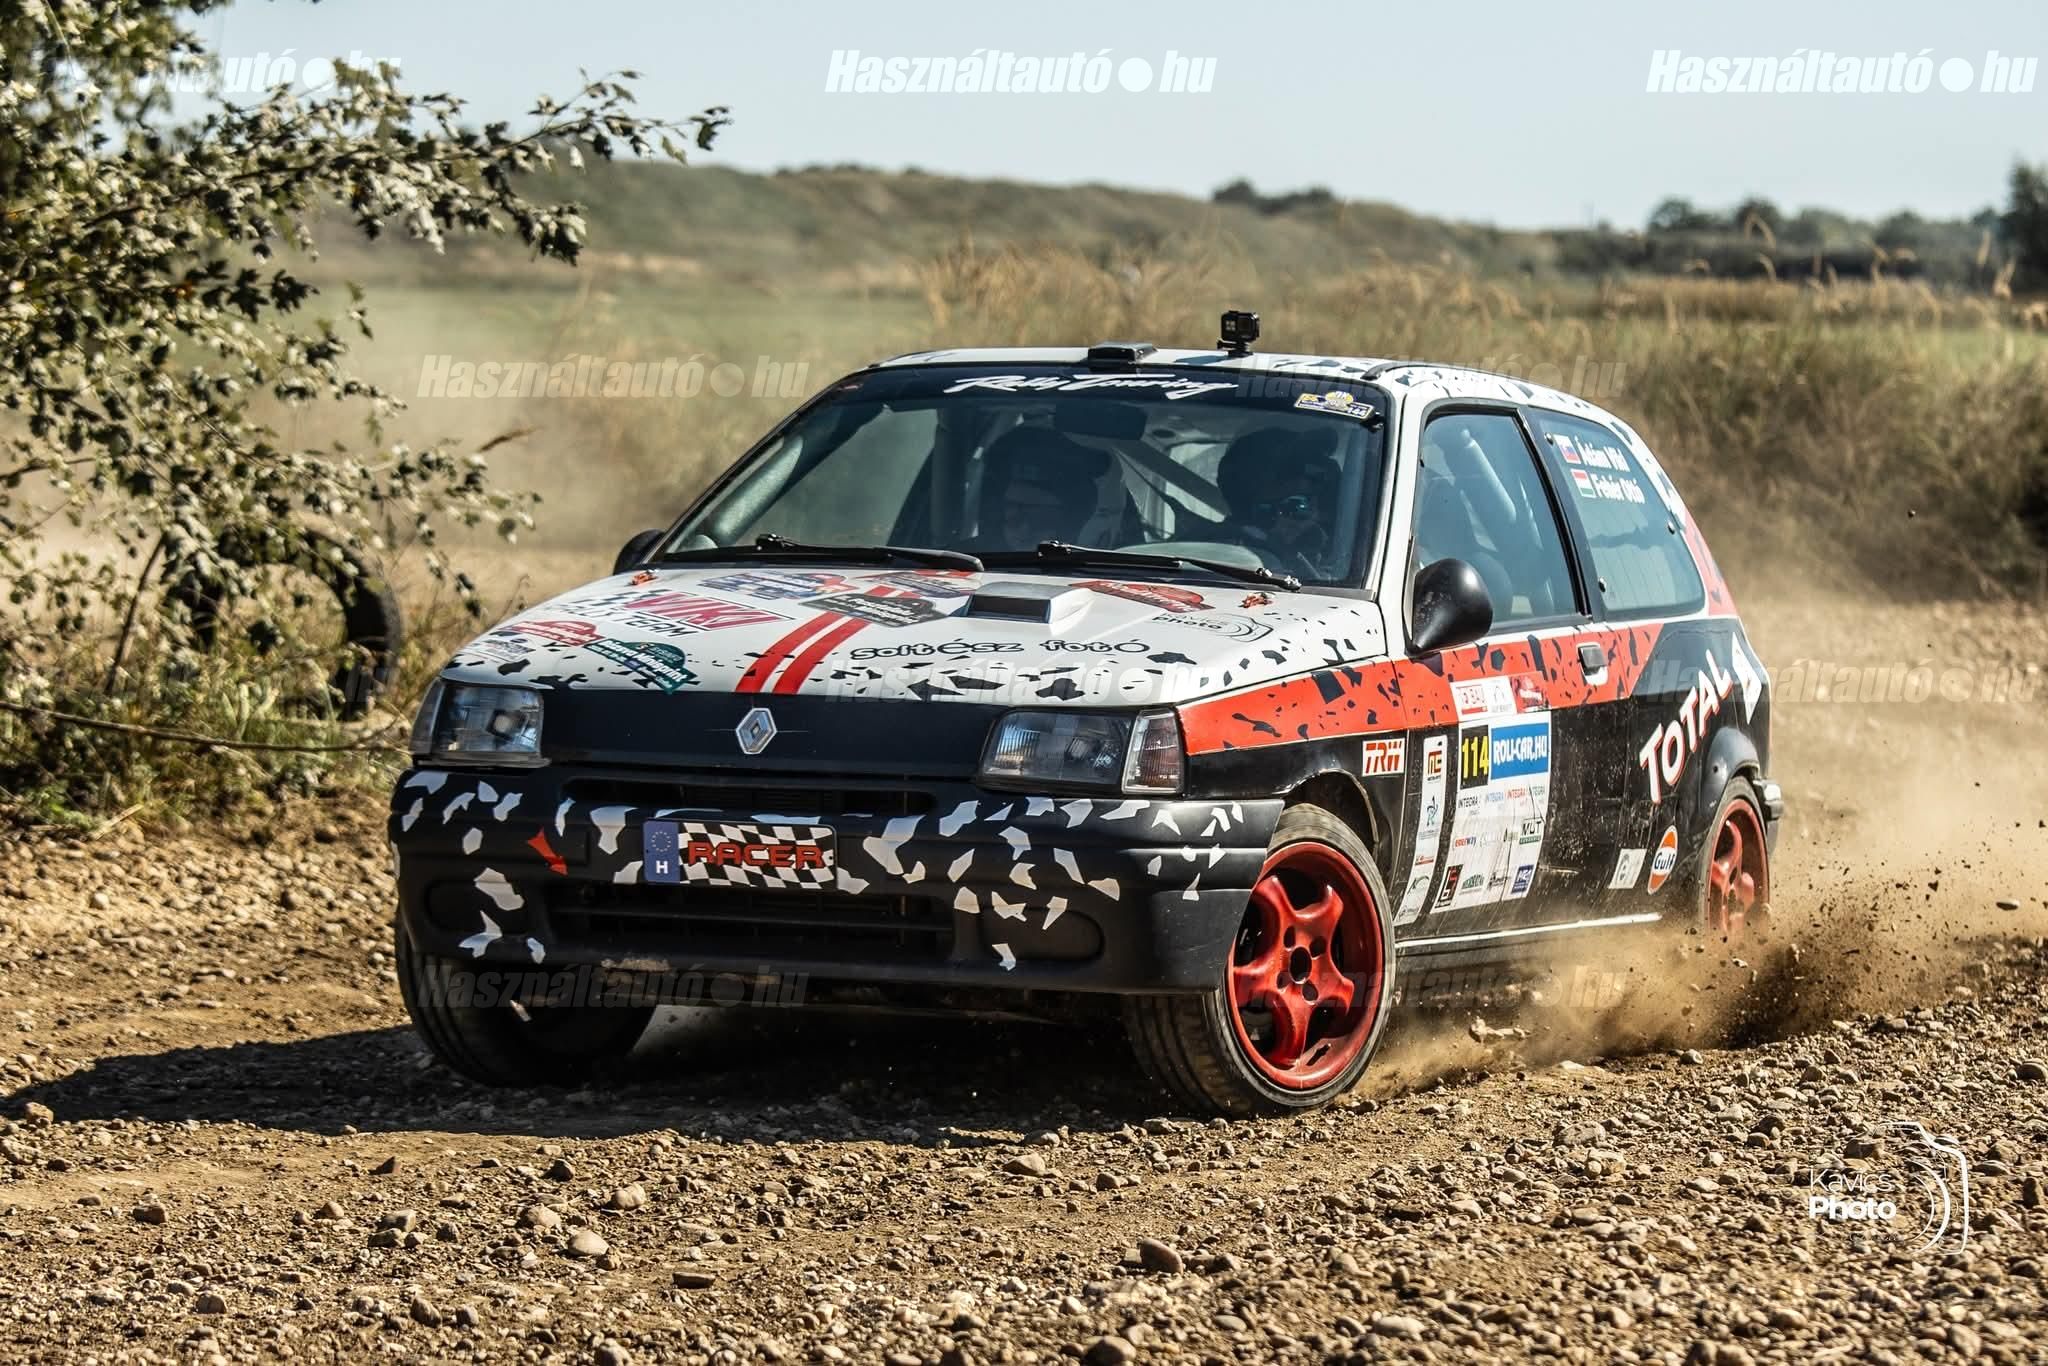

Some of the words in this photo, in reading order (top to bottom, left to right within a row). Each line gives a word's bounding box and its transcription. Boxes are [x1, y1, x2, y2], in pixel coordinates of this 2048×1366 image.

[612, 615, 699, 637] TEAM
[1639, 649, 1734, 805] TOTAL
[1366, 741, 1402, 774] TRW
[1462, 735, 1489, 779] 114
[655, 860, 669, 874] H
[688, 840, 826, 869] RACER
[1654, 851, 1676, 870] Gulf
